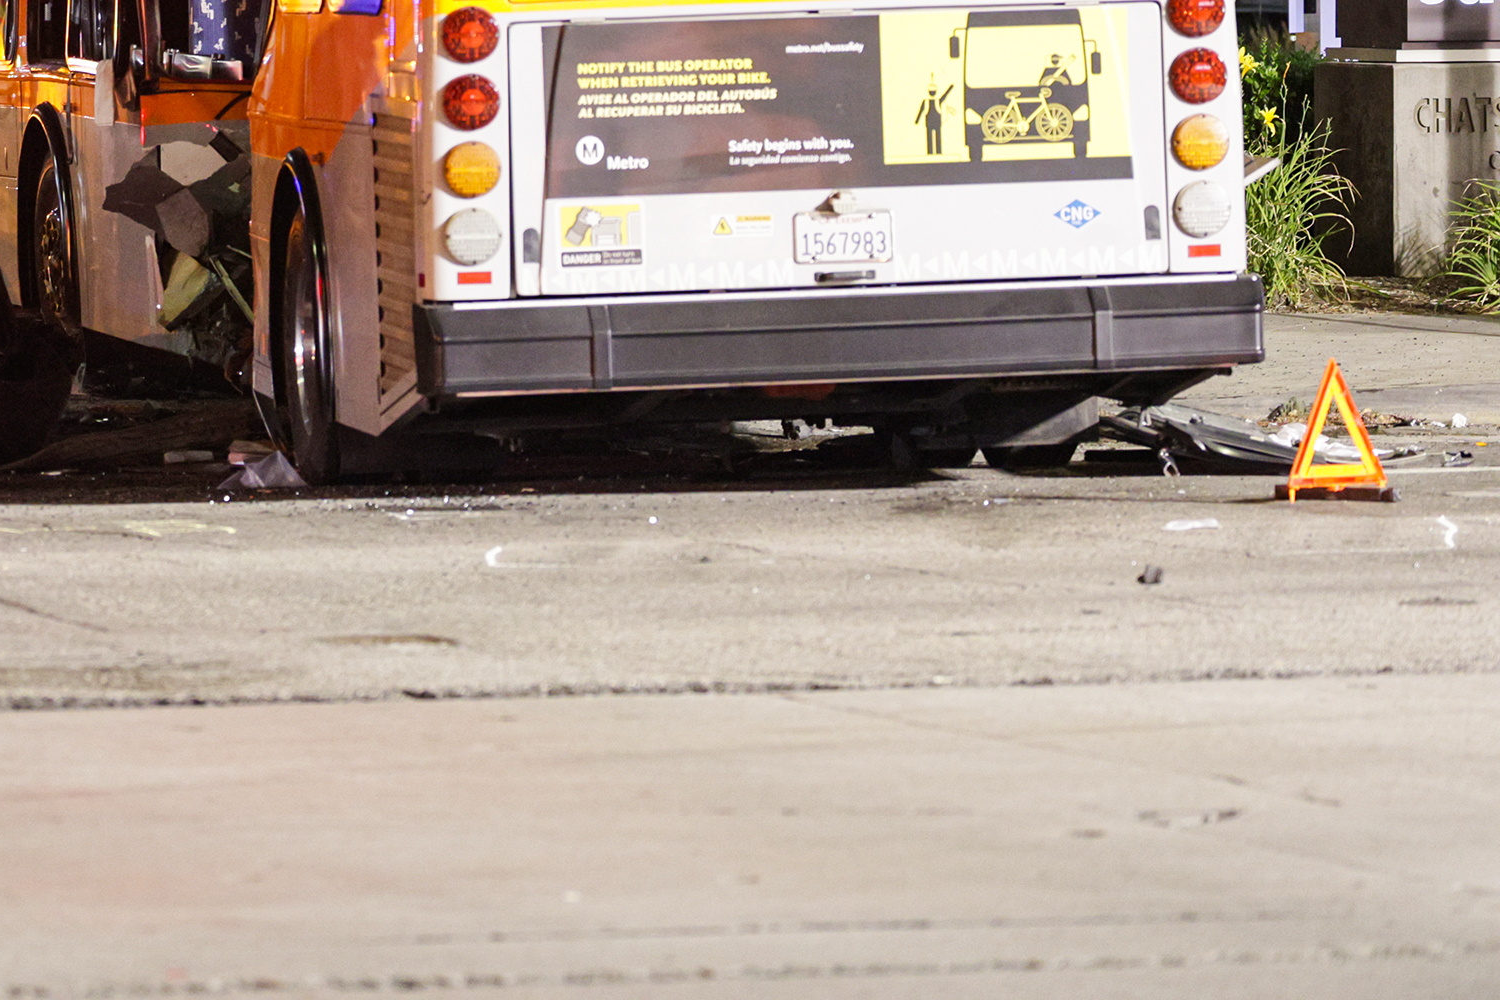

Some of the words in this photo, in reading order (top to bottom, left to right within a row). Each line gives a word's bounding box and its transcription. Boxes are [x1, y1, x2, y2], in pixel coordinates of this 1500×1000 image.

[577, 62, 626, 75] NOTIFY
[627, 61, 655, 73] THE
[656, 60, 682, 72] BUS
[683, 58, 753, 71] OPERATOR
[577, 77, 619, 89] WHEN
[621, 74, 698, 88] RETRIEVING
[699, 73, 736, 85] YOUR
[737, 71, 772, 84] BIKE.
[578, 93, 613, 105] AVISE
[613, 93, 629, 104] AL
[630, 91, 695, 104] OPERADOR
[696, 89, 719, 102] DEL
[720, 86, 778, 100] AUTOBÚS
[578, 107, 594, 119] AL
[595, 105, 664, 118] RECUPERAR
[665, 104, 682, 116] SU
[683, 102, 745, 115] BICICLETA.
[728, 138, 763, 155] Safety
[764, 137, 802, 154] begins
[803, 136, 828, 150] with
[829, 138, 854, 152] you.
[607, 156, 649, 170] Metro
[1060, 205, 1095, 221] CNG
[801, 231, 887, 255] 1567983
[562, 252, 602, 265] DANGER
